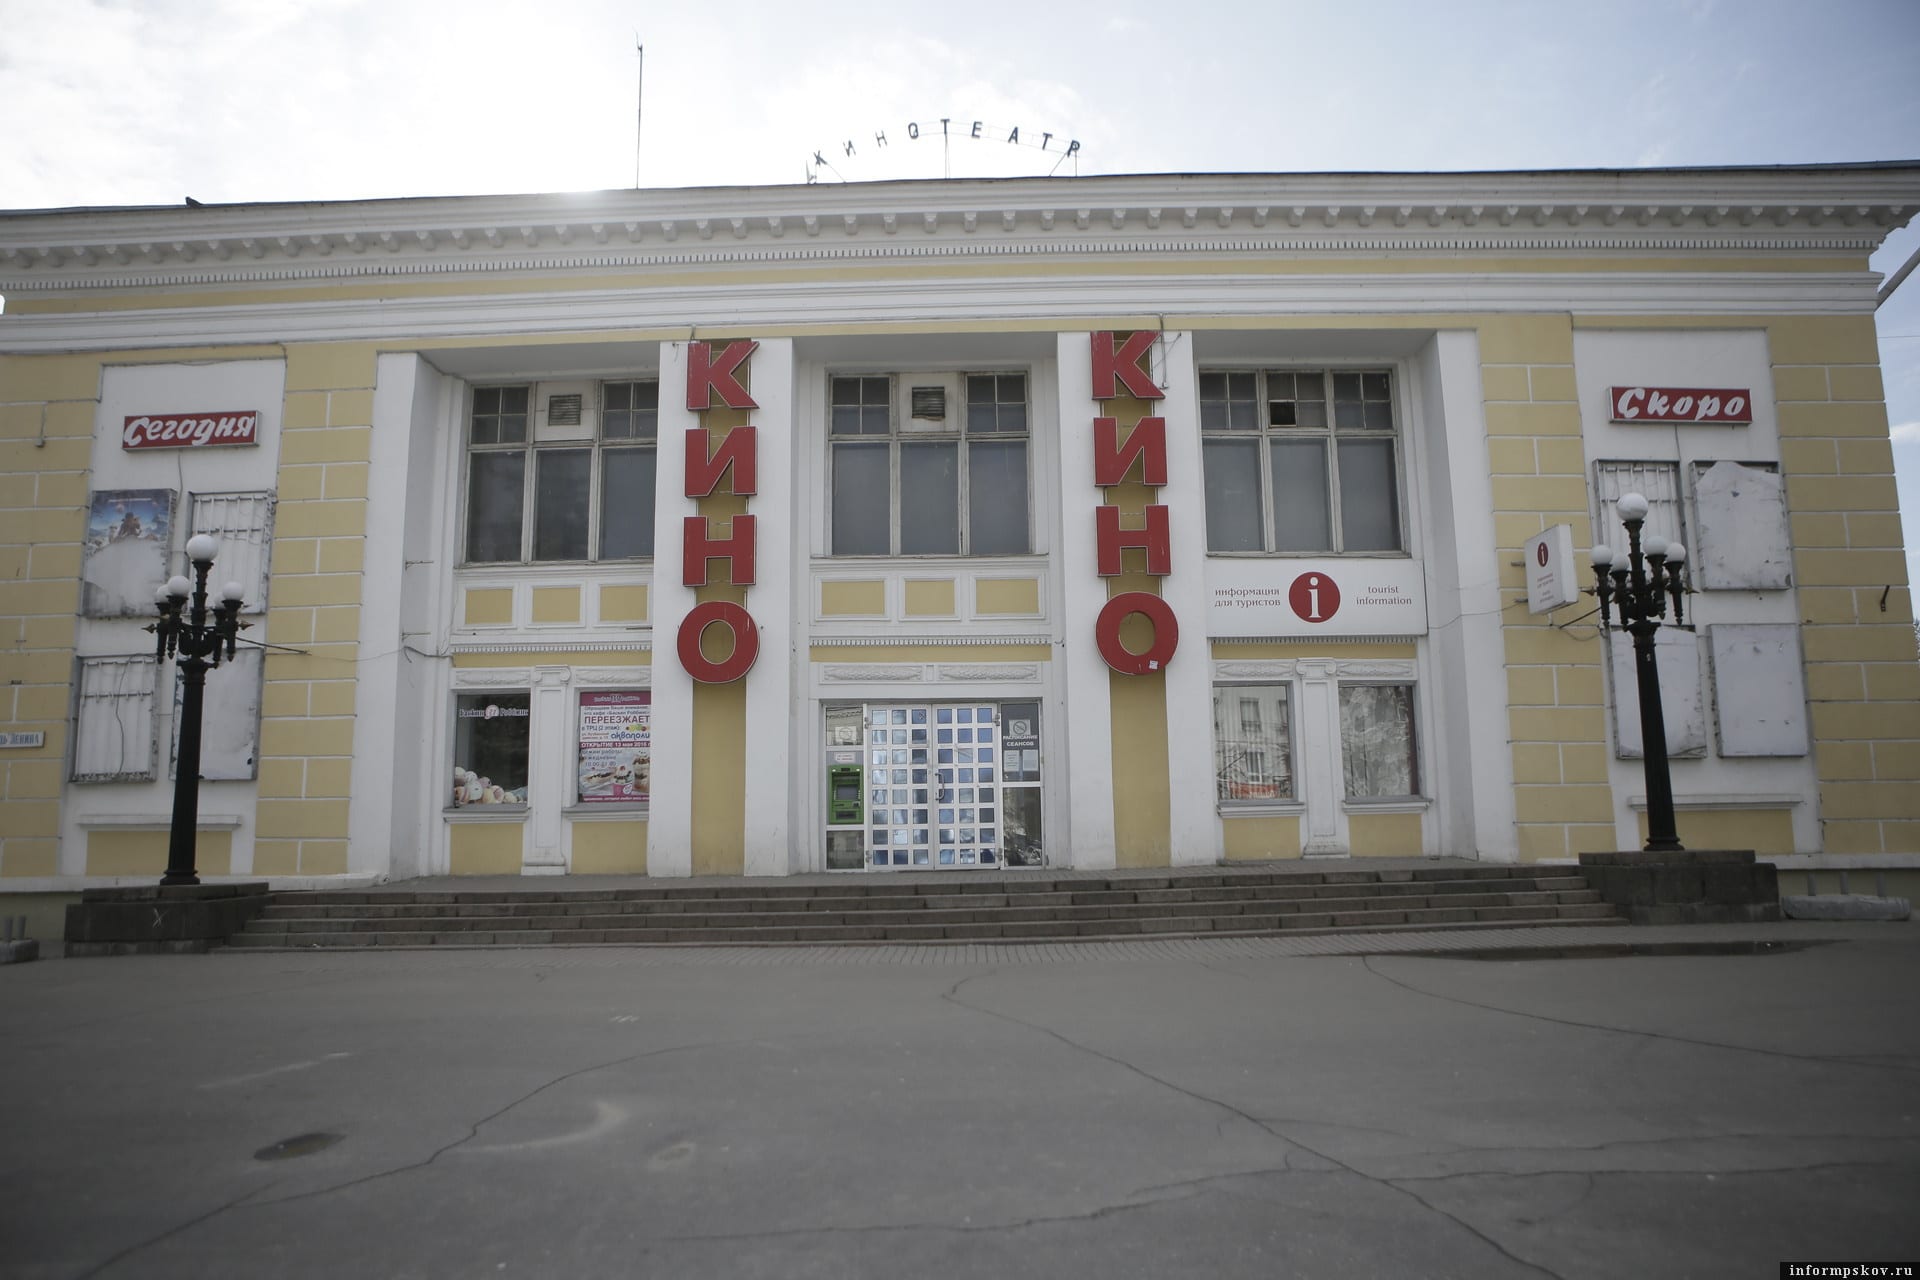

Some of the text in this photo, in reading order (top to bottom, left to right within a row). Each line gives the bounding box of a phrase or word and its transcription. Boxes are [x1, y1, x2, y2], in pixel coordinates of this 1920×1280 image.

[813, 118, 1081, 167] КИНОТЕАТР
[1617, 388, 1745, 421] Скоро
[123, 416, 255, 446] Сегодня
[677, 341, 760, 684] КИНО
[1090, 331, 1179, 675] КИНО
[1215, 587, 1280, 597] информация
[1367, 585, 1399, 594] tourist
[1235, 599, 1281, 608] туристов
[1356, 596, 1412, 605] information
[584, 715, 650, 724] ПЕРЕЕЗЖАЕТ
